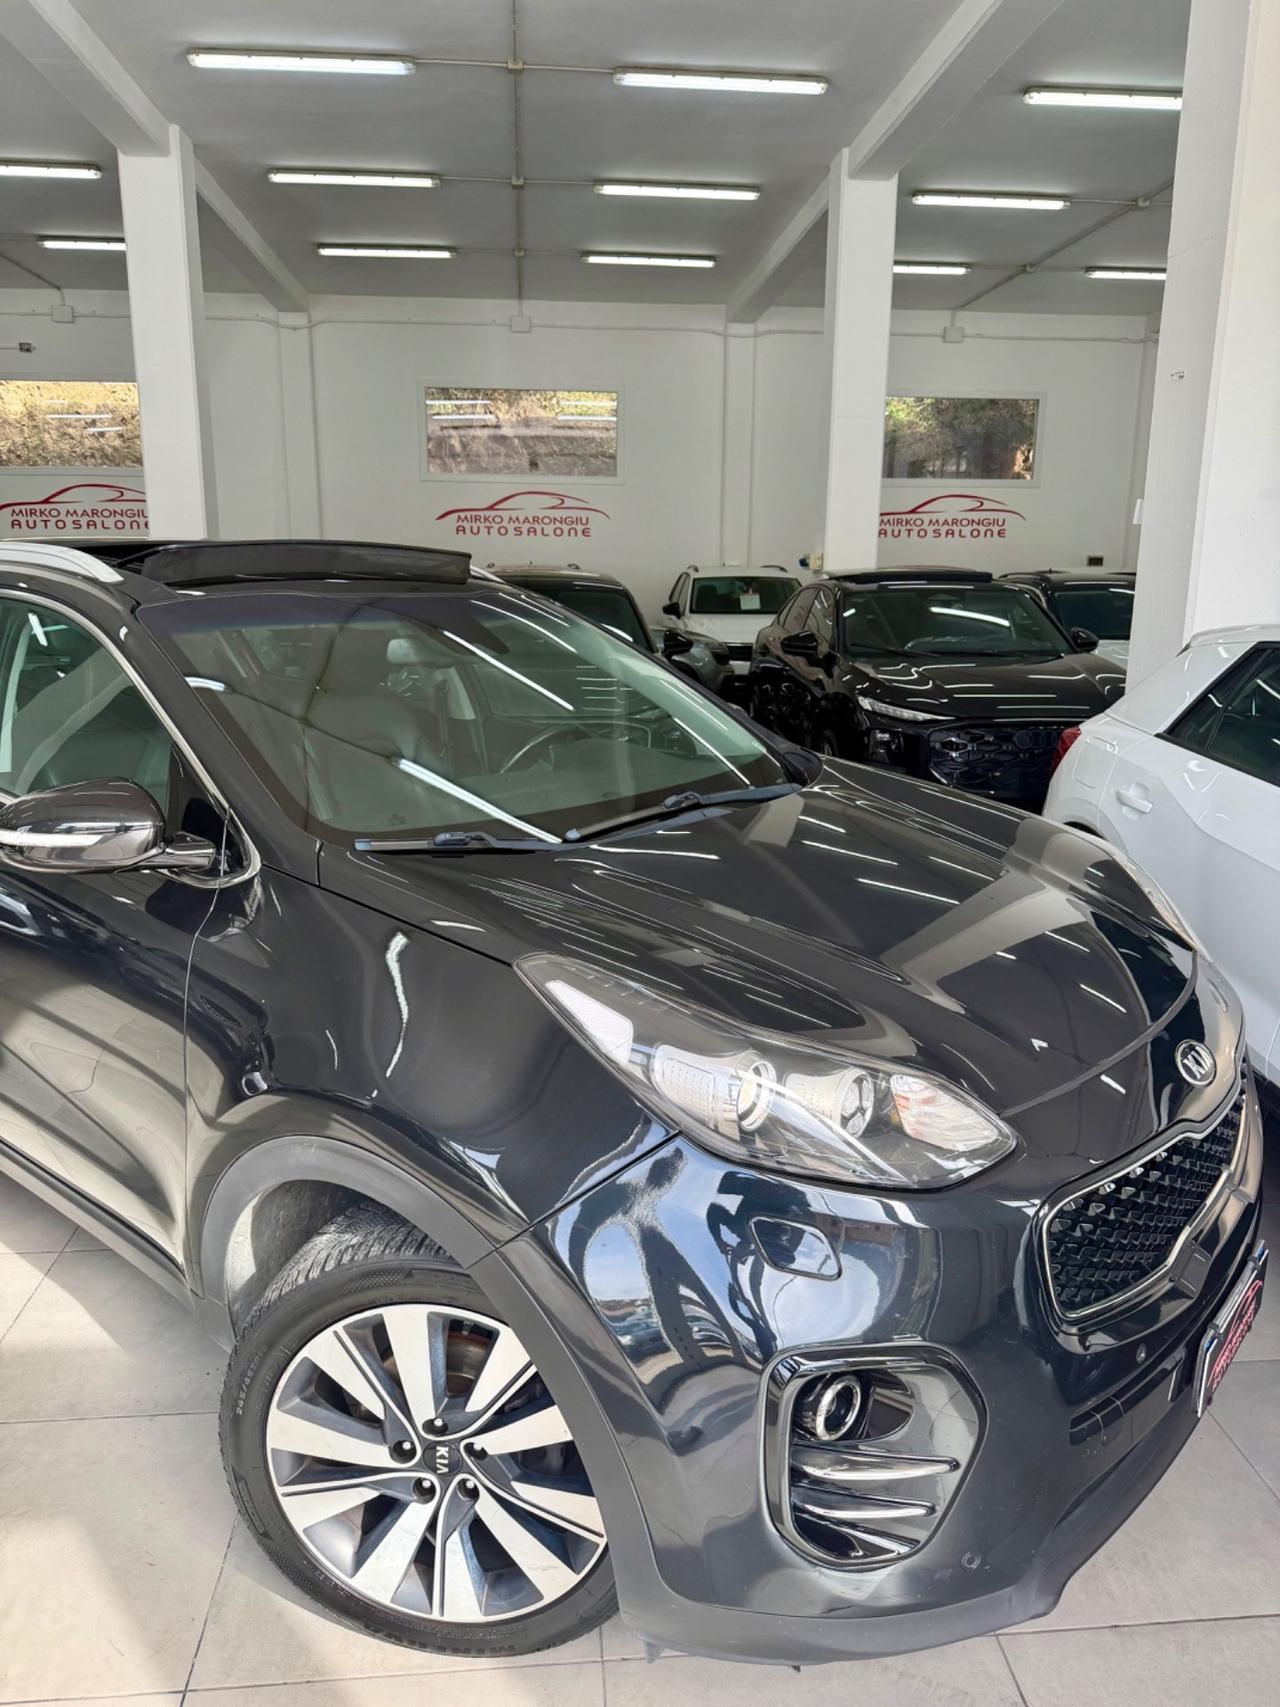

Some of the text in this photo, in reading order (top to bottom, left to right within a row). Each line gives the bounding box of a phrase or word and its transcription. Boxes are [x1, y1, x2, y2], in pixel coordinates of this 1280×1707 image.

[11, 508, 61, 518] MIRKO
[456, 514, 590, 526] MIRKO MARONGIU
[879, 517, 1006, 528] MIRKO MARONGIU
[455, 525, 592, 538] AUTOSALONE
[878, 528, 1007, 539] AUTOSALONE
[1183, 1046, 1212, 1079] KIA
[436, 1446, 449, 1474] KIA
